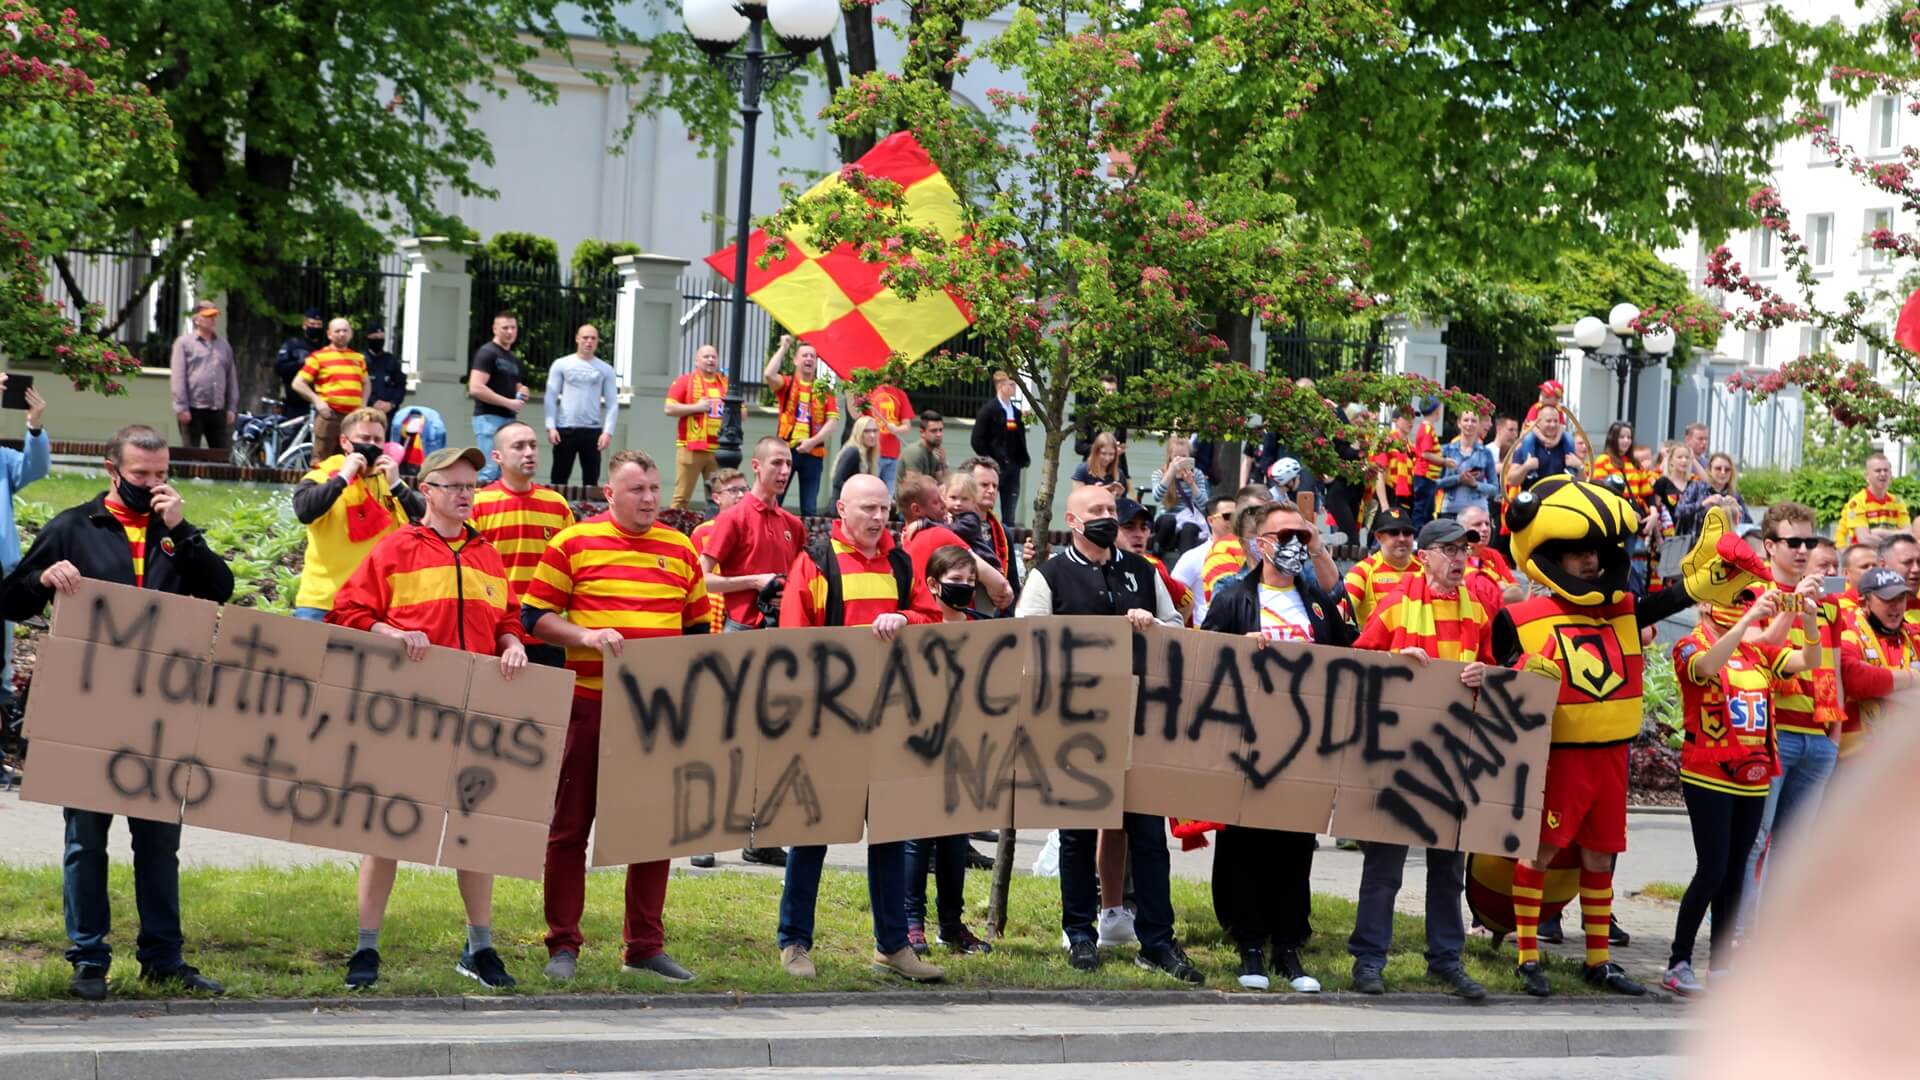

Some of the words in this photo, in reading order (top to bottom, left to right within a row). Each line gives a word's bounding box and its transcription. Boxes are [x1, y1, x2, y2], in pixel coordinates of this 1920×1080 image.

[326, 637, 547, 769] Tomas
[619, 625, 1116, 765] WYGRAJCIE
[1132, 631, 1414, 790] HAJDE
[1729, 690, 1767, 733] STS
[106, 718, 214, 807] do
[669, 746, 823, 847] DLA
[943, 725, 1115, 814] NAS
